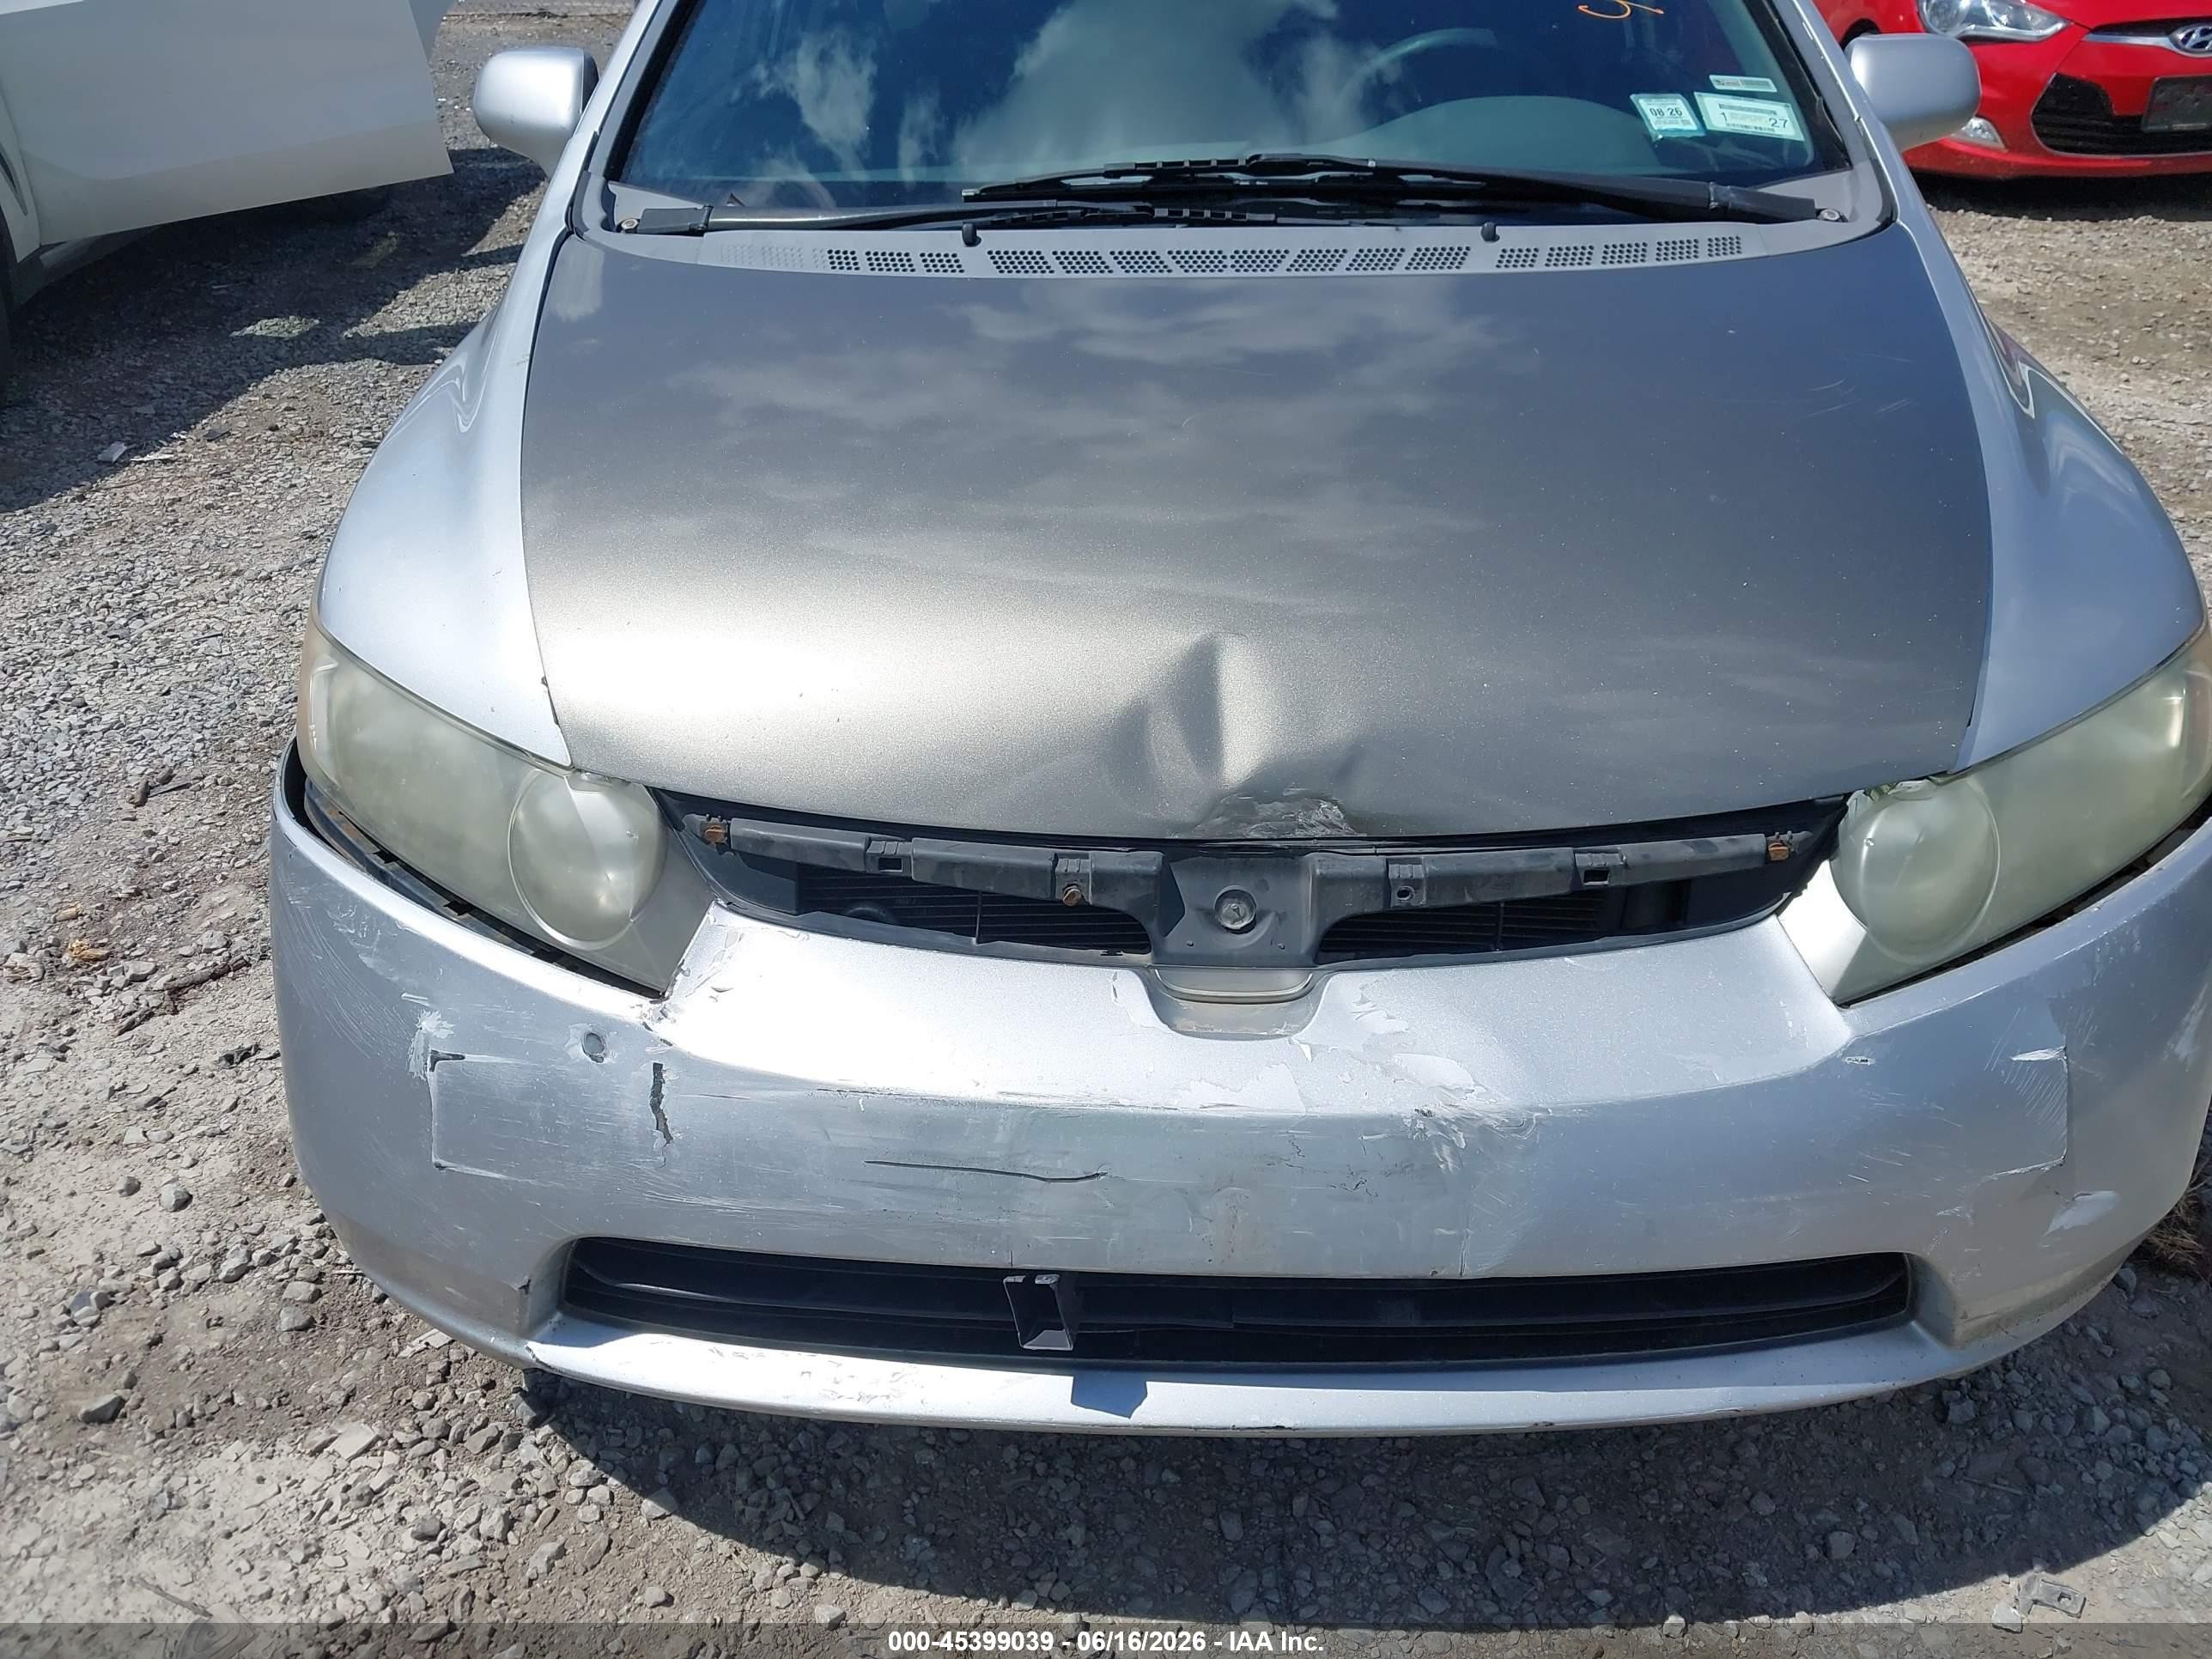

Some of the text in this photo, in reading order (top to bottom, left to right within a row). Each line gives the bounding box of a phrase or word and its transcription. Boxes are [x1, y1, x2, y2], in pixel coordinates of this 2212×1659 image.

[1667, 107, 1683, 117] 26
[1720, 112, 1728, 122] 1
[1769, 118, 1789, 129] 27
